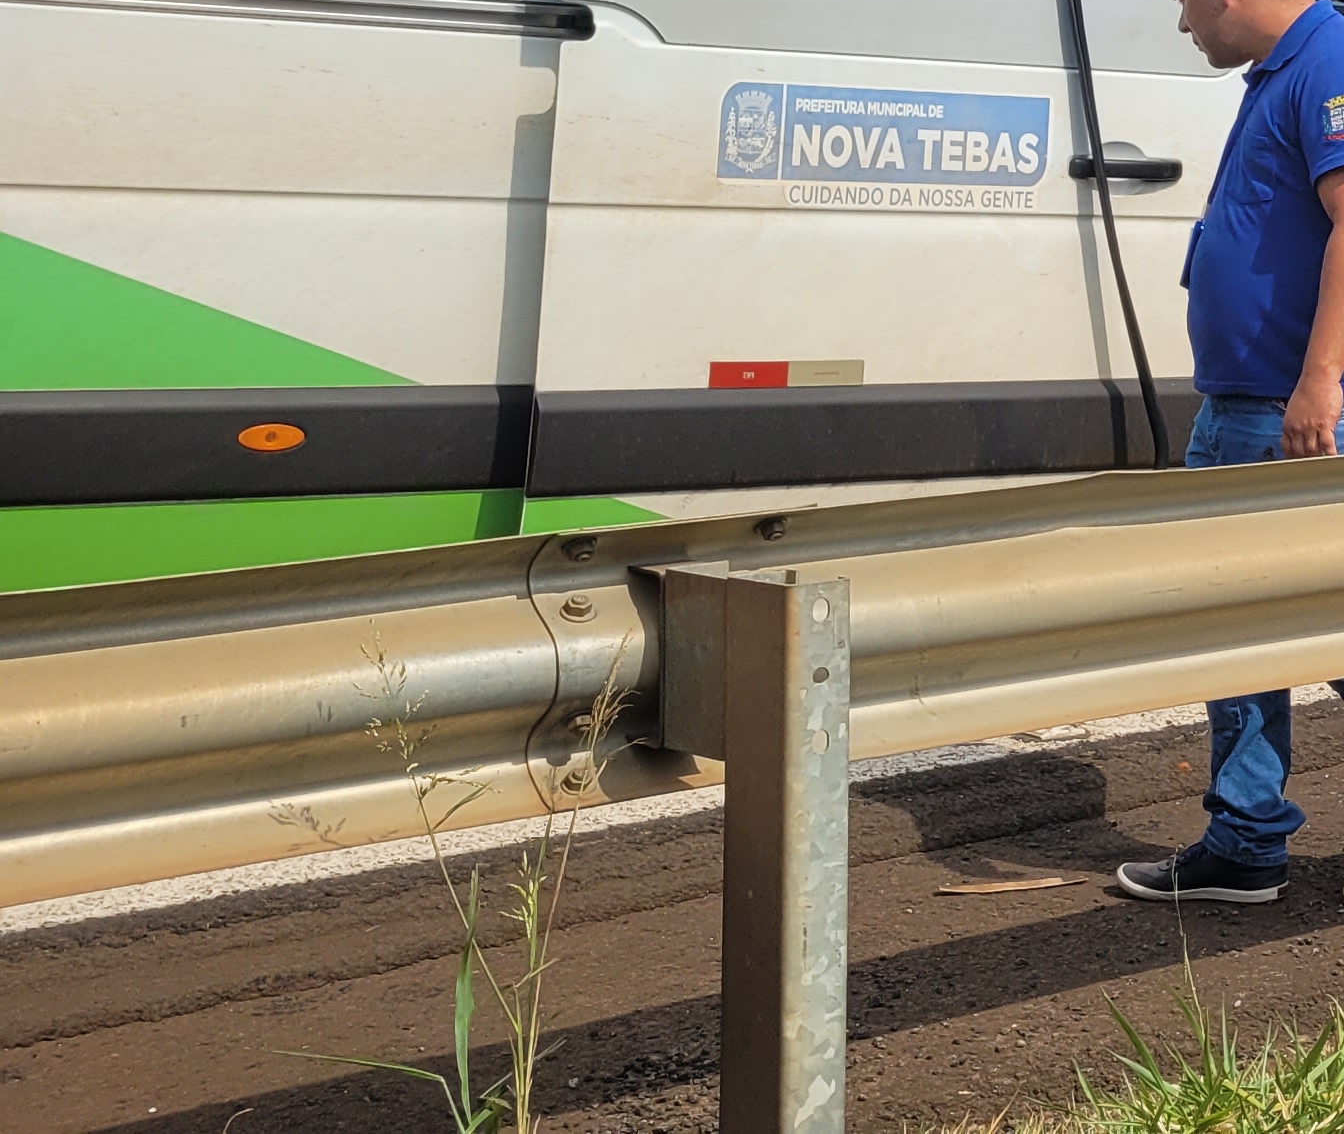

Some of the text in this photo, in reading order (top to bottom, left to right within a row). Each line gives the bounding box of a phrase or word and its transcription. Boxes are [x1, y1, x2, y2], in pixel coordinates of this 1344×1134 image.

[795, 97, 944, 119] PREFEITURA MUNICIPAL DE
[791, 124, 1040, 175] NOVA TEBAS
[789, 185, 1035, 209] CUIDANDO DA NOSSA GENTE
